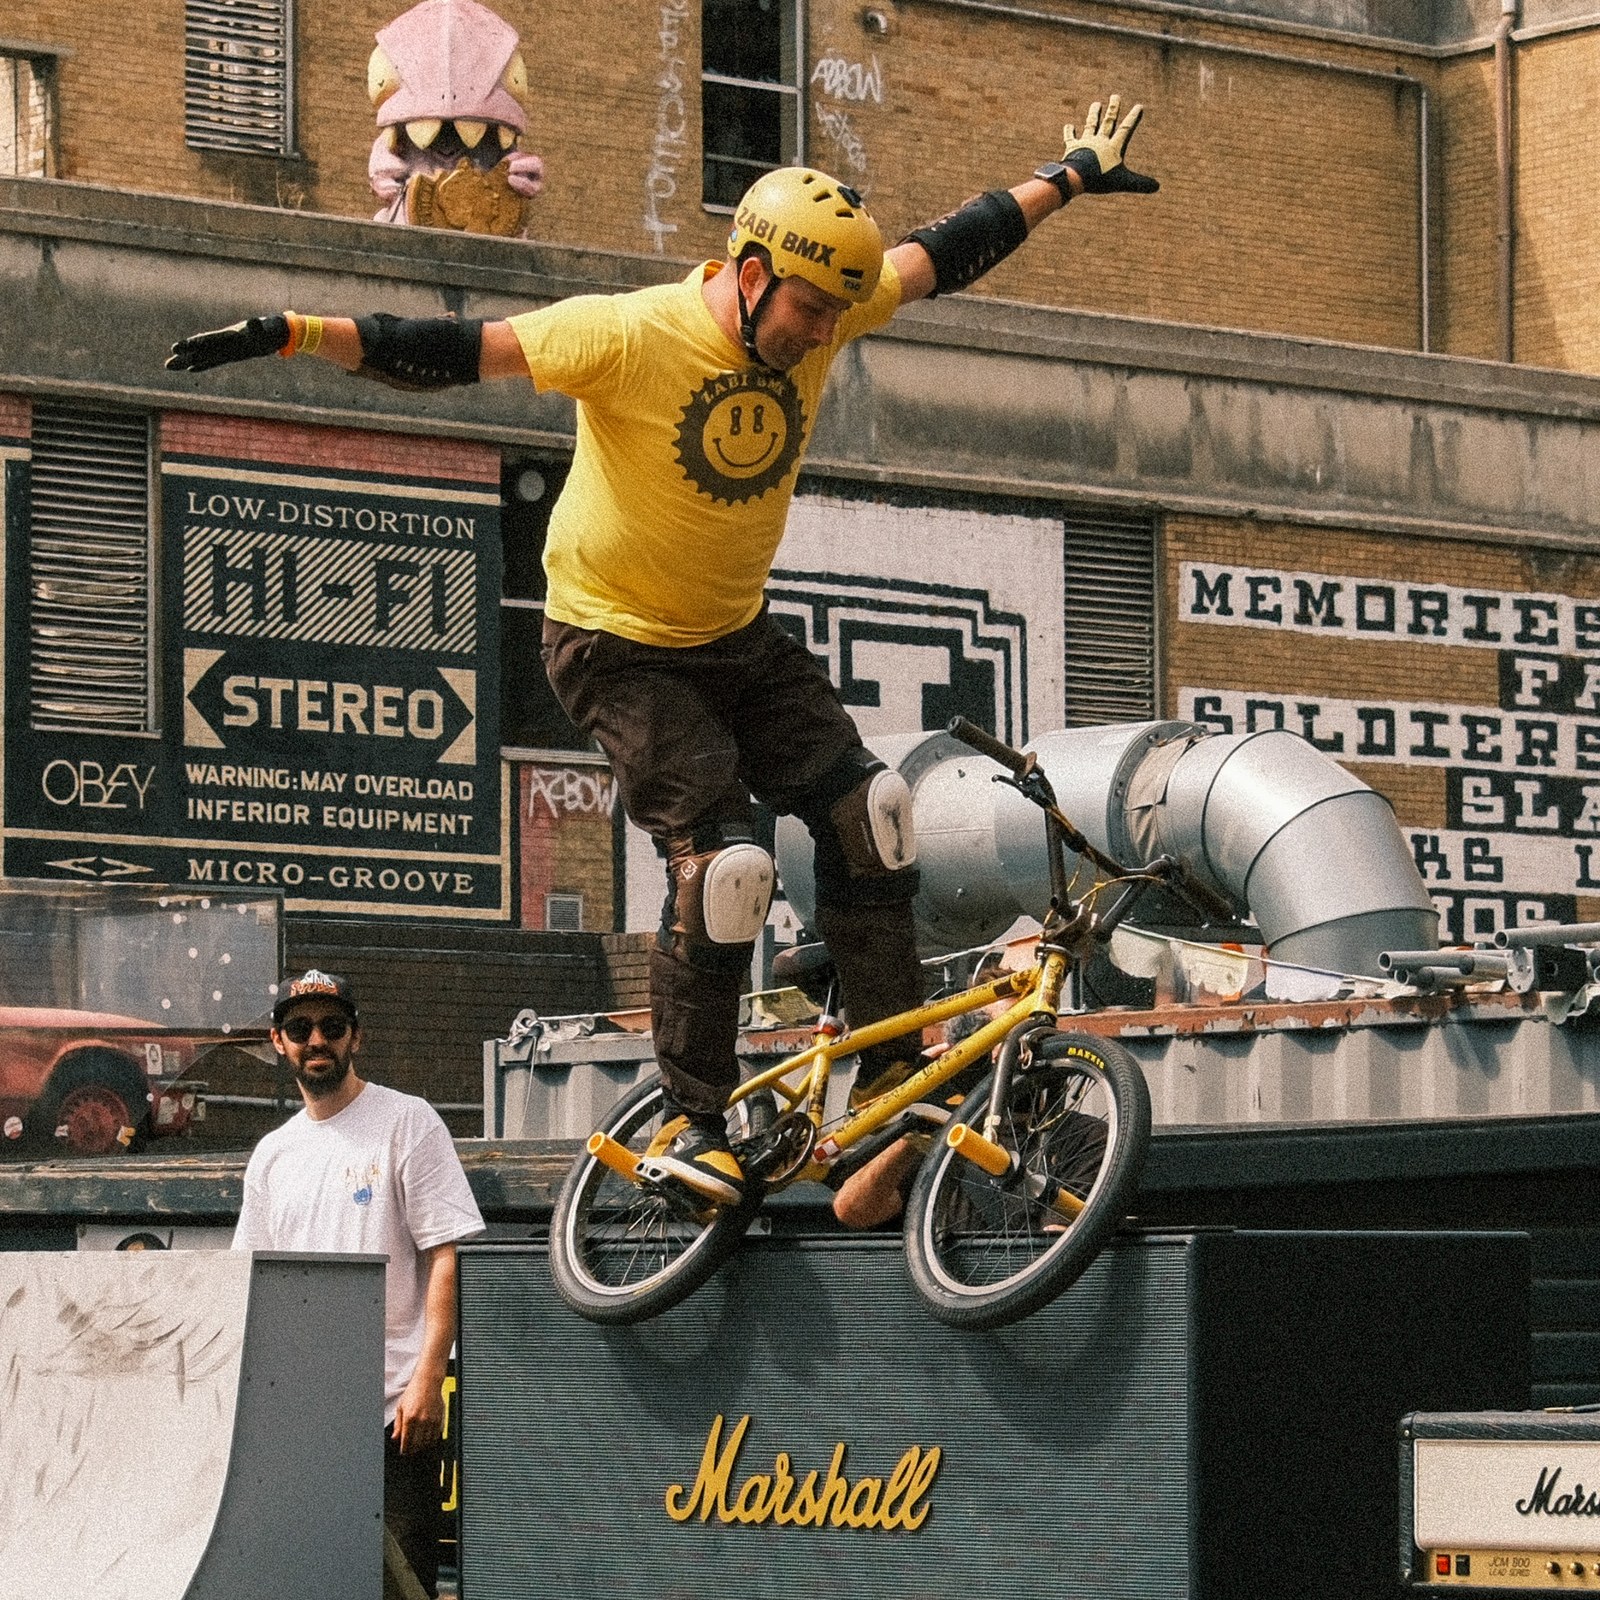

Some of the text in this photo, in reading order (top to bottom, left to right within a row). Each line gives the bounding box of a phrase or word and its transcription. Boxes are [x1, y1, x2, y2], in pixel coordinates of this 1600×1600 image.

[737, 206, 836, 267] ZABI BMX
[187, 491, 476, 540] LOW-DISTORTION
[211, 542, 446, 636] HI-FI
[1190, 569, 1600, 650] MEMORIES
[222, 675, 444, 740] STEREO
[1194, 696, 1600, 771] SOLDIERS
[42, 758, 157, 809] OBEY
[355, 773, 474, 801] OVERLOAD
[187, 798, 473, 836] INFERIOR EQUIPMENT
[187, 859, 475, 895] MICRO-GROOVE
[1067, 1047, 1105, 1069] MAXXIS
[665, 1413, 942, 1531] Marshall
